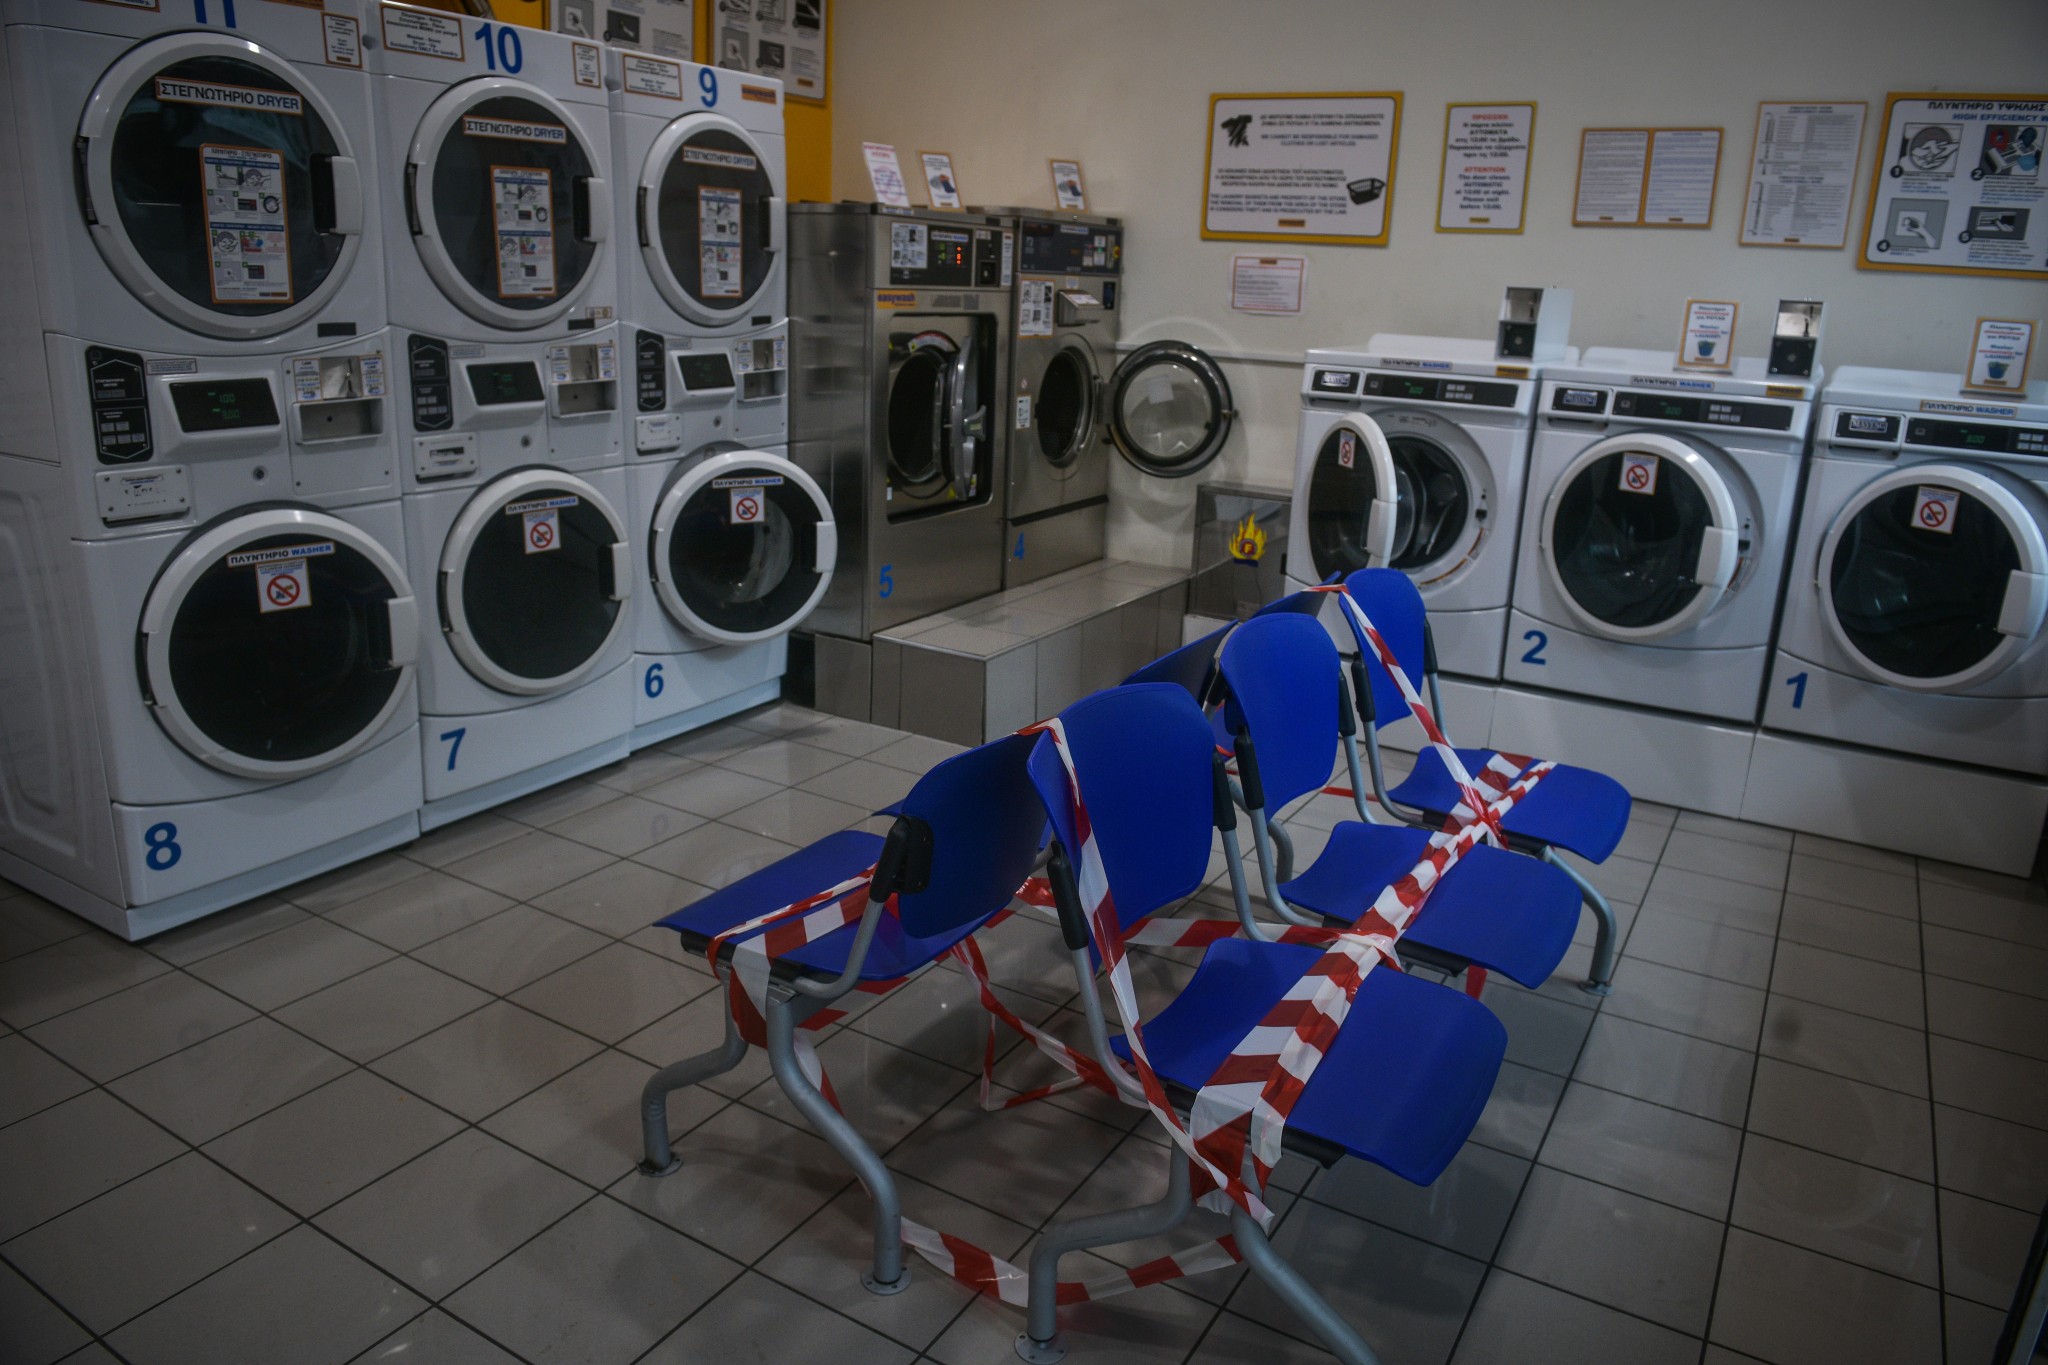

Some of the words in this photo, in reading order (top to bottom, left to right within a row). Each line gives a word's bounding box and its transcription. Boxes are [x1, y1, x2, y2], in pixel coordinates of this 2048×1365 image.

[474, 22, 522, 74] 10
[161, 83, 254, 104] ΣΤΕΓΝΩΤΗΡΙΟ
[257, 94, 299, 109] DRYER
[699, 68, 718, 107] 9
[1928, 102, 1993, 110] ΠΛΥΝΤΗΡΙΟ
[1980, 114, 2038, 122] EFFICIENCY
[534, 128, 564, 139] DRYER
[1925, 402, 1974, 412] ΠΛΥΝΤΗΡΙΟ
[1976, 406, 2014, 416] WASHER
[230, 550, 289, 564] ΠΛΥΝΤΗΡΙΟ
[291, 545, 331, 556] WASHER
[1013, 532, 1024, 560] 4
[880, 564, 894, 599] 5
[1521, 630, 1548, 665] 2
[645, 662, 665, 698] 6
[1786, 672, 1808, 709] 1
[440, 727, 466, 770] 7
[144, 822, 182, 872] 8
